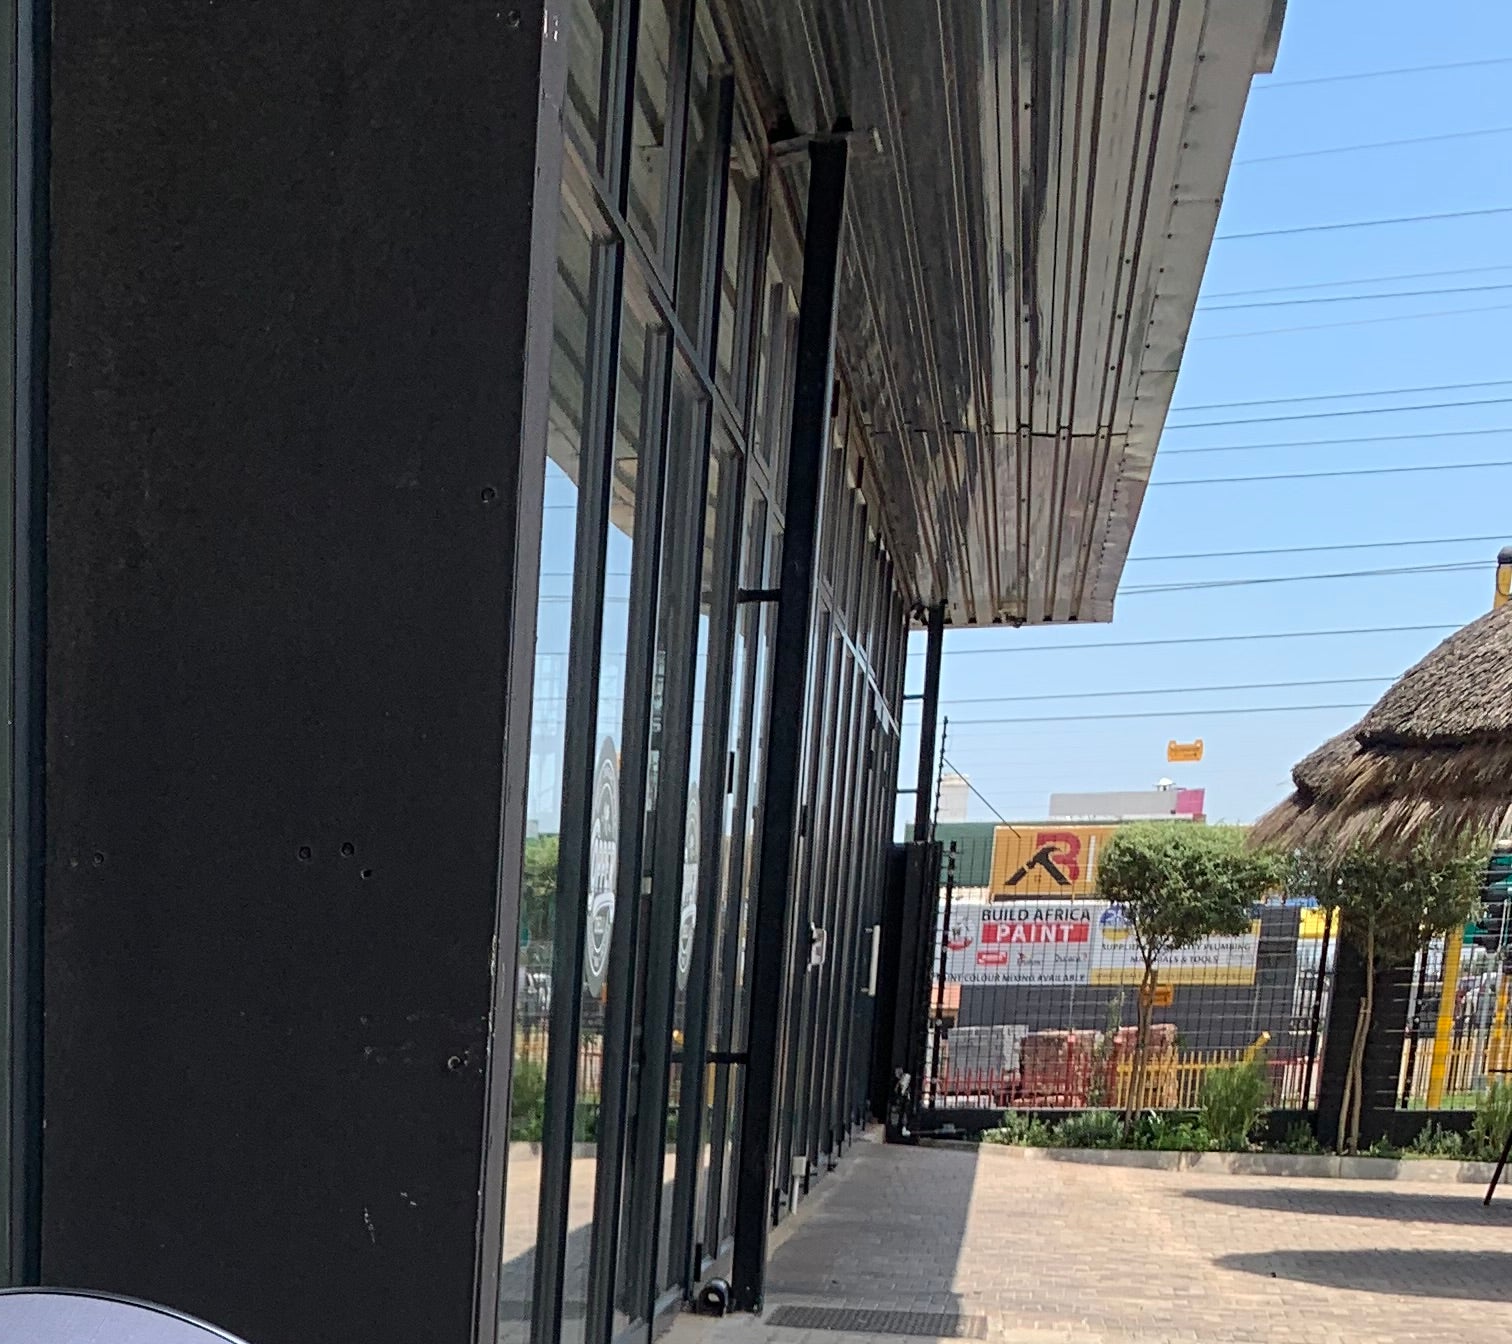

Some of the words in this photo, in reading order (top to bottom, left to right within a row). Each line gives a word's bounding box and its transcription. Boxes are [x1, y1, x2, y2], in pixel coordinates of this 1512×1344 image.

[982, 909, 1029, 921] BUILD
[1033, 908, 1090, 921] AFRICA
[997, 925, 1074, 942] PAINT
